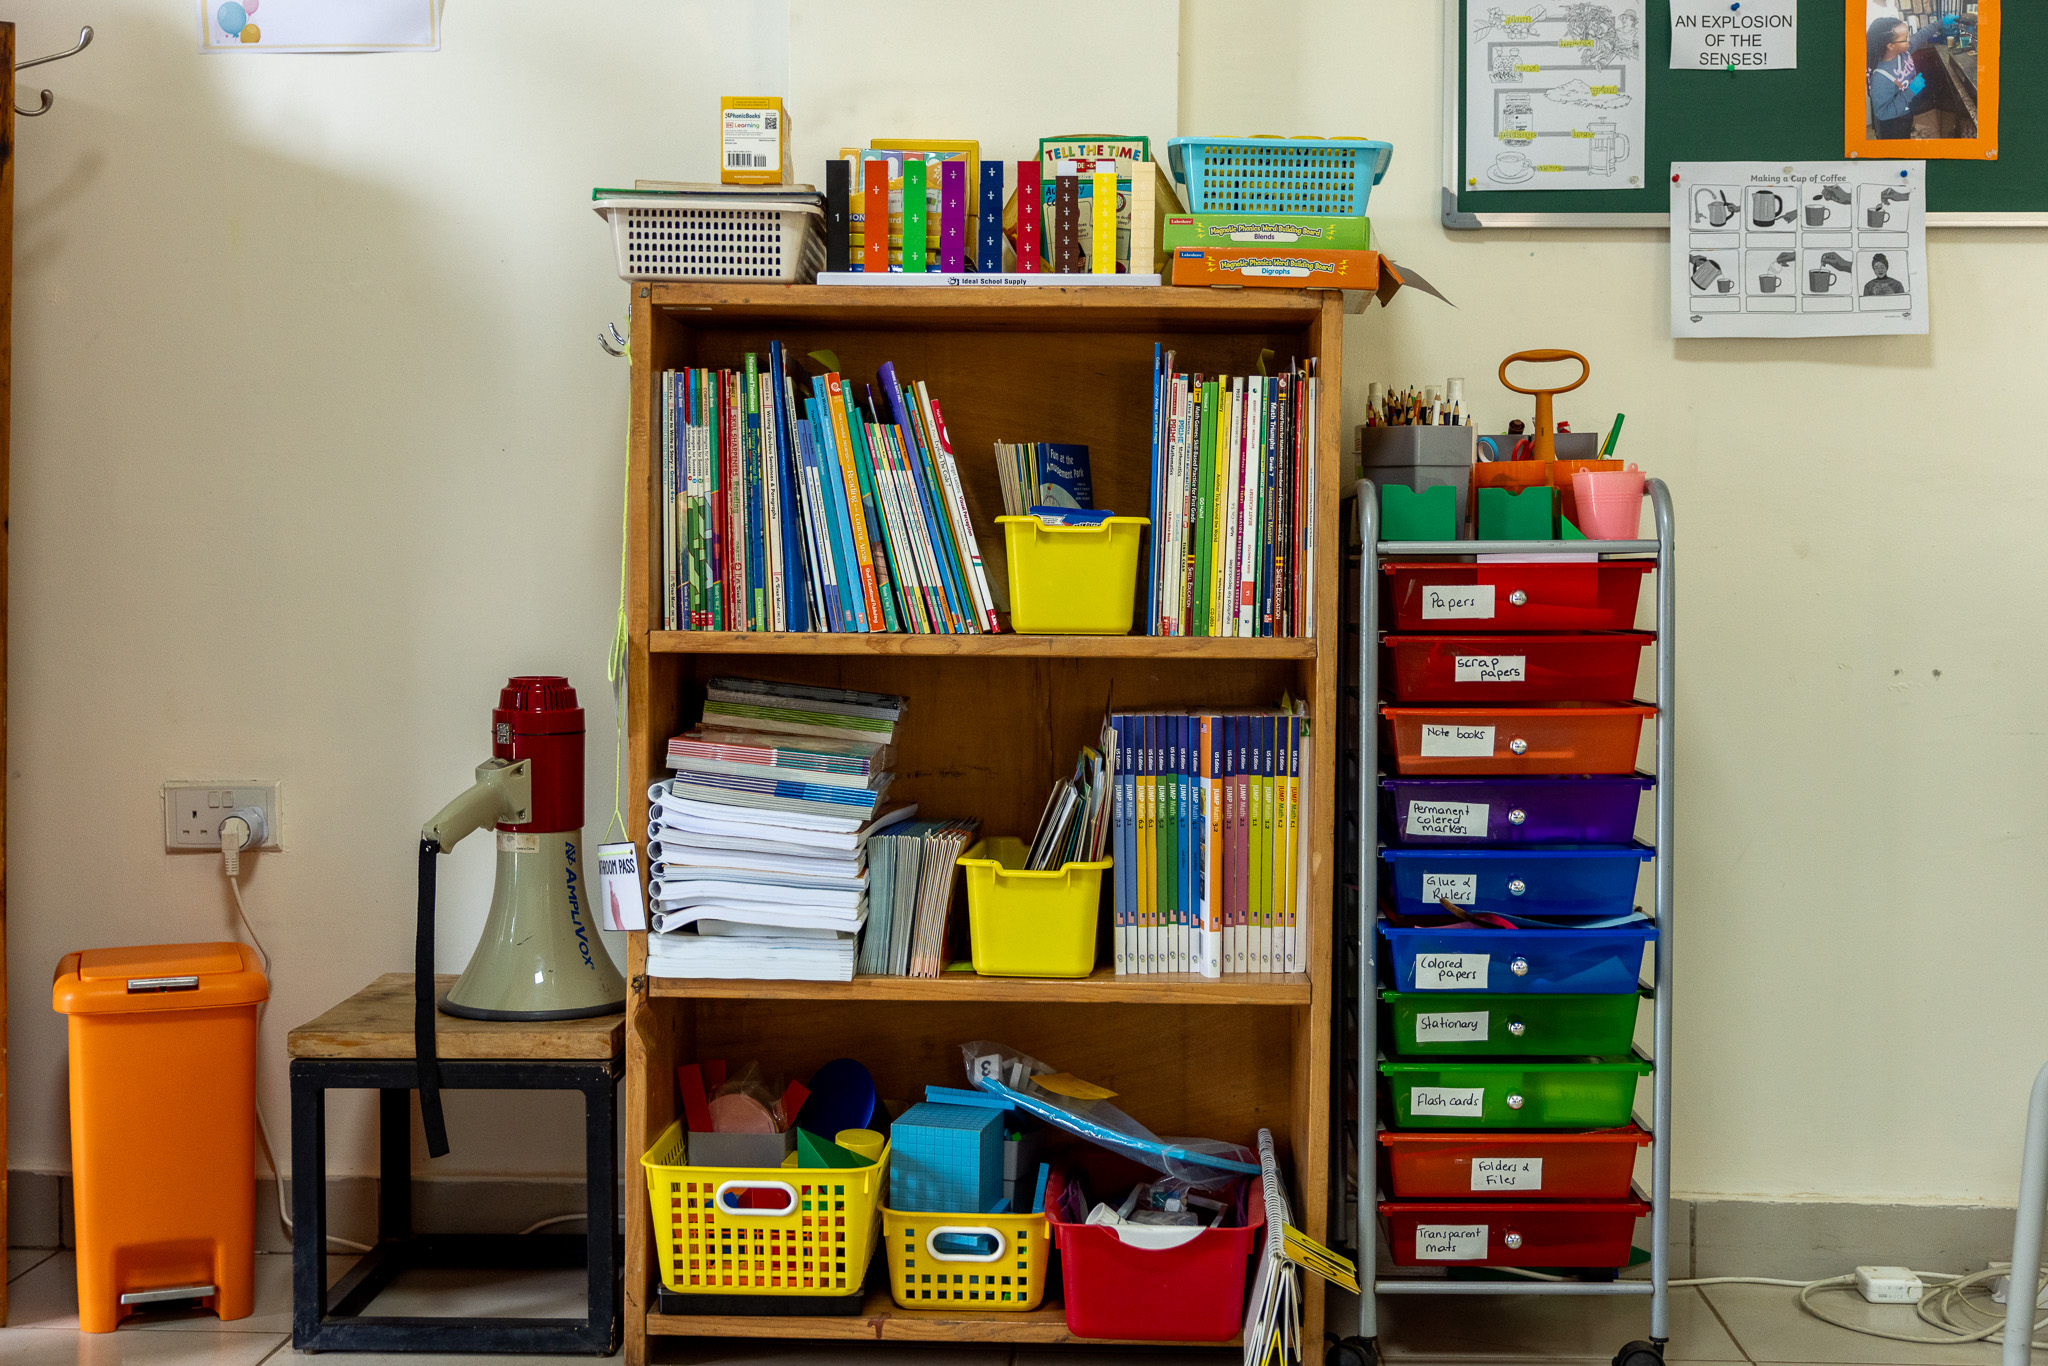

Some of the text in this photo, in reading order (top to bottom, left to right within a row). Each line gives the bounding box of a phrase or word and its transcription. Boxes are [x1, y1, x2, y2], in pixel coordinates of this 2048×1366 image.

[1675, 15, 1792, 28] AN EXPLOSION
[1705, 34, 1762, 46] OF THE
[1699, 52, 1767, 65] SENSES!
[1045, 145, 1141, 161] TELL THE TIME
[1750, 175, 1780, 184] Making
[1790, 175, 1807, 183] Cup
[1810, 174, 1818, 183] of
[1820, 174, 1846, 182] Coffee
[834, 212, 841, 222] 1
[1210, 224, 1321, 237] Magnetic Phonics Word Building Board
[1220, 259, 1334, 272] Magnetic Phonics Word Building Board
[1268, 421, 1276, 450] Triumphs
[934, 440, 943, 459] Explode
[939, 461, 947, 470] The
[1050, 449, 1059, 461] Fun
[1059, 455, 1065, 463] at
[1047, 462, 1084, 479] Amusement Park
[847, 470, 867, 562] Reading Content Areas
[962, 511, 973, 537] Perception
[1430, 592, 1475, 611] Papers
[1480, 668, 1520, 681] papers
[1427, 727, 1486, 740] Note books
[1413, 803, 1470, 816] Permanent
[1421, 824, 1467, 834] markers
[619, 859, 635, 874] PASS
[1426, 877, 1456, 886] Glue
[1433, 888, 1472, 900] Rulers
[565, 867, 595, 967] AMPLIVOX
[1421, 956, 1463, 969] Colored
[1438, 969, 1476, 981] papers
[1421, 1016, 1478, 1031] Stationary
[1417, 1093, 1480, 1107] Flash cards
[1478, 1161, 1517, 1172] Folders
[1486, 1175, 1516, 1186] Files
[1417, 1228, 1482, 1245] Transparent
[1425, 1243, 1456, 1252] mats
